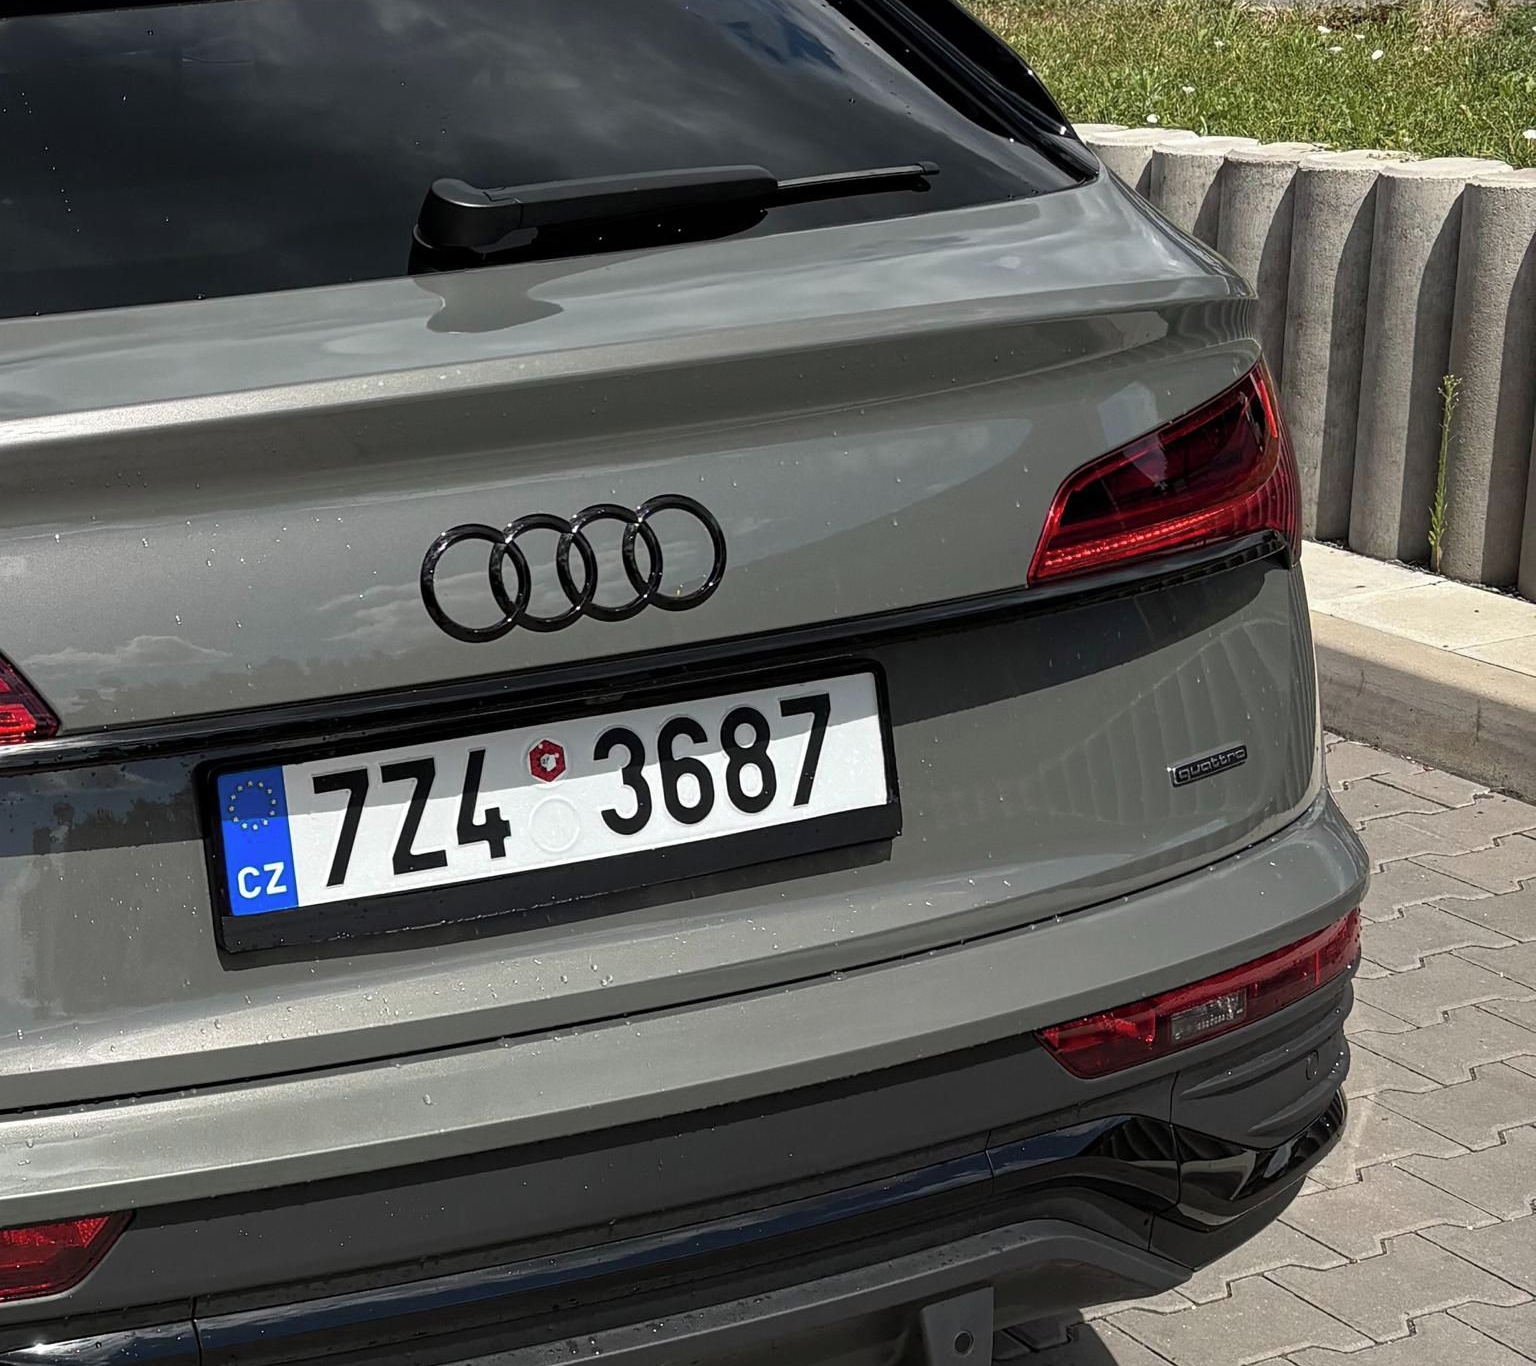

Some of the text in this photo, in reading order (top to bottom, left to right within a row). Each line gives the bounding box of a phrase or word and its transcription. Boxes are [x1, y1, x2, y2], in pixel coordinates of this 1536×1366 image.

[237, 692, 832, 899] CZ 7Z4 3687
[1178, 748, 1246, 781] quattro
